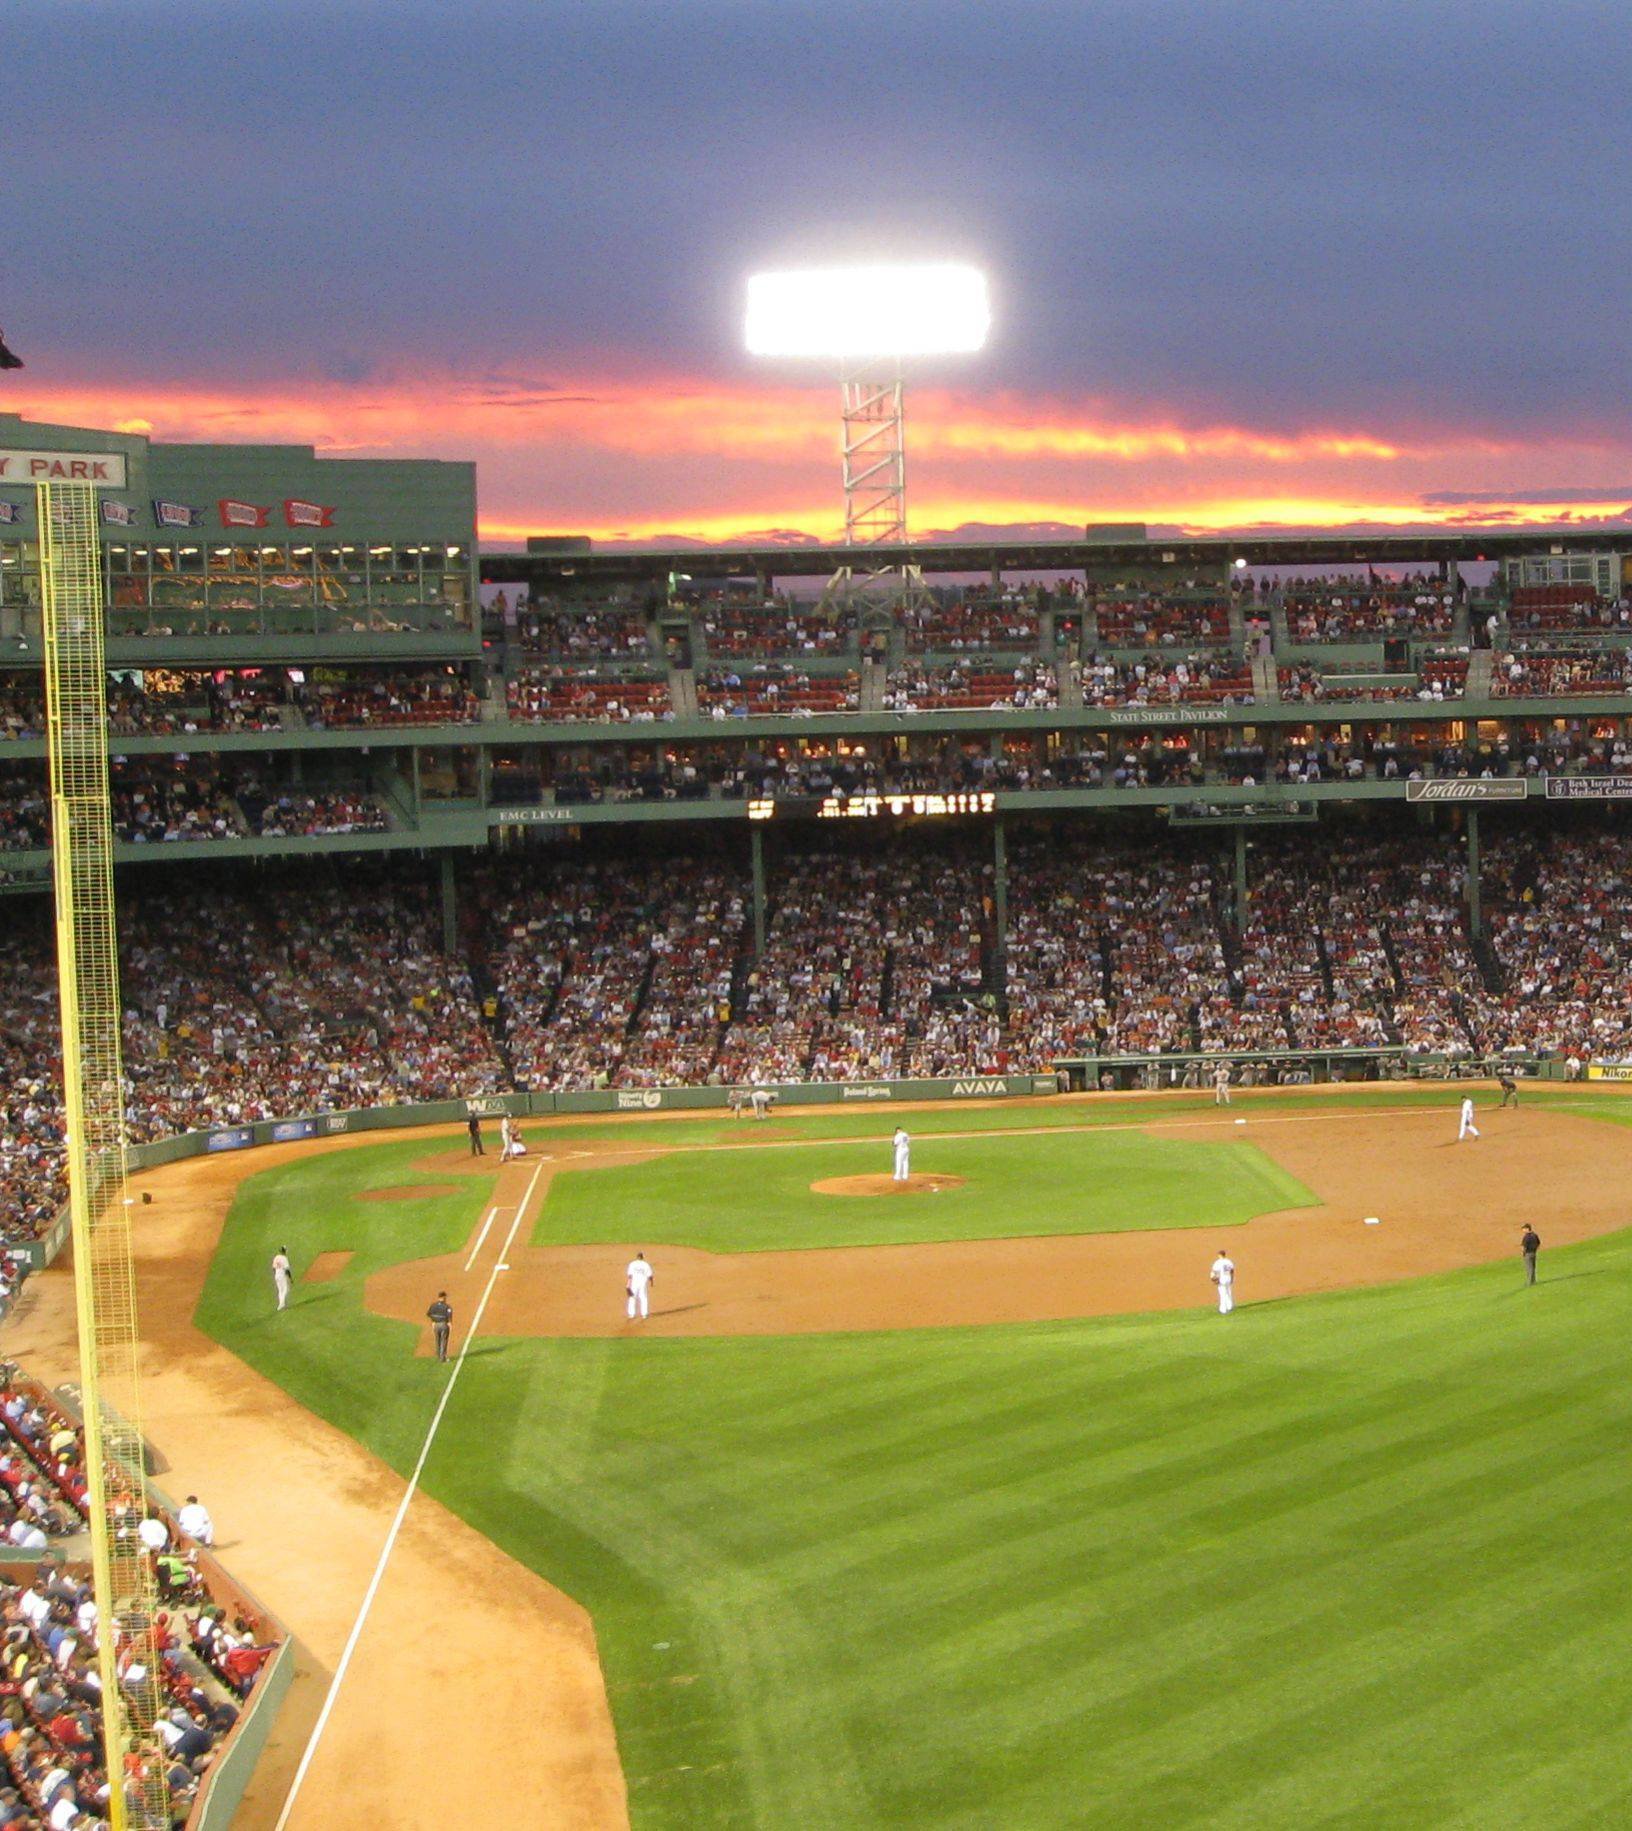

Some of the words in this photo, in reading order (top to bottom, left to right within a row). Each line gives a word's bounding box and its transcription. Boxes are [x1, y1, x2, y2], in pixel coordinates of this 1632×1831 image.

[30, 458, 108, 480] PARK
[1110, 711, 1138, 723] STATE
[1140, 710, 1177, 722] STREET
[1180, 708, 1228, 721] PAVILION
[1416, 779, 1488, 800] Jordan's
[1568, 779, 1586, 788] Beth
[1590, 779, 1614, 788] Israel
[1569, 787, 1603, 797] Medical
[500, 810, 528, 821] EMC
[532, 808, 574, 820] LEVEL
[953, 1080, 1007, 1095] AVAYA
